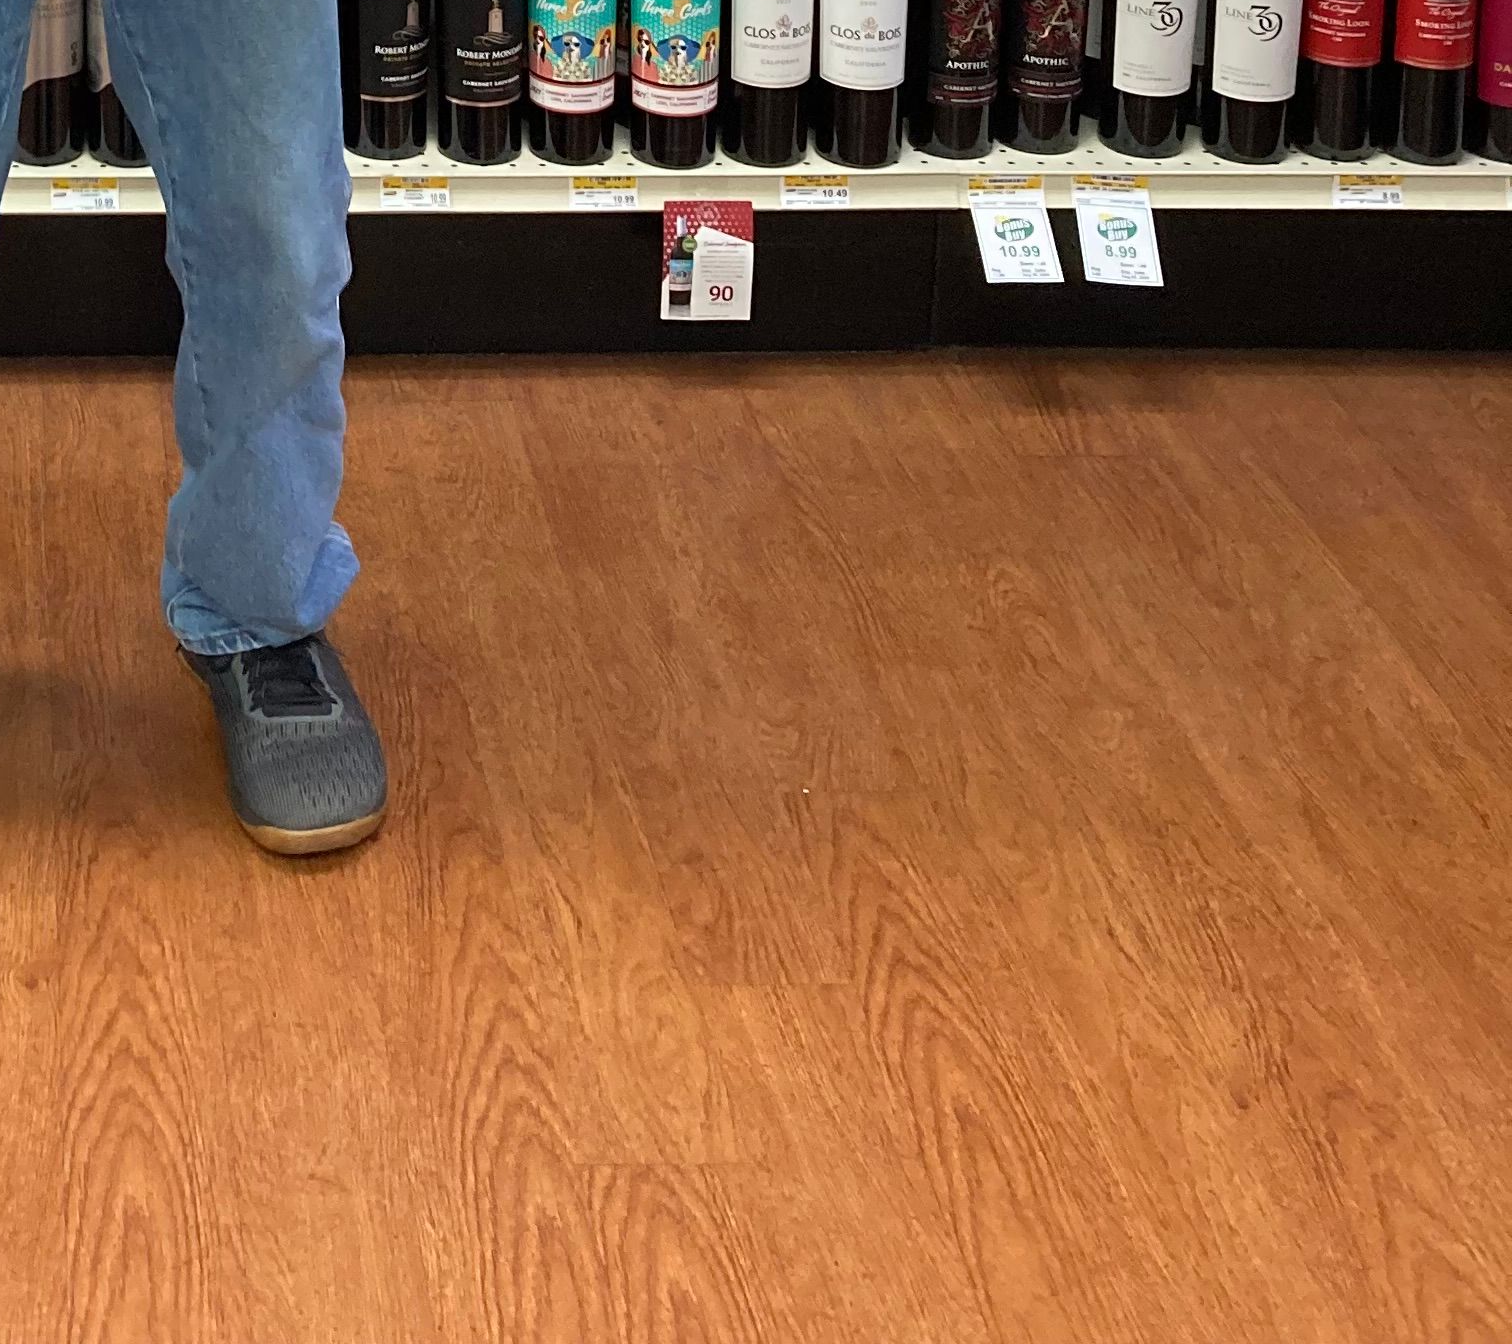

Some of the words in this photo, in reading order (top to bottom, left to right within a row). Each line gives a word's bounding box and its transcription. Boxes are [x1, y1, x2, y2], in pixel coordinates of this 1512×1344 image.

[678, 1, 713, 20] Girls
[1127, 3, 1155, 17] LINE
[1150, 1, 1184, 37] 39
[1225, 6, 1253, 20] LINE
[1248, 4, 1284, 42] 39
[1347, 18, 1371, 28] LOON
[1415, 18, 1455, 29] SMOKING
[744, 26, 776, 39] CLOS
[792, 22, 811, 38] BOIS
[830, 24, 862, 40] CLOS
[878, 27, 902, 41] BOIS
[375, 43, 407, 55] ROBERT
[456, 47, 491, 60] ROBERT
[946, 59, 990, 70] APOTHIC
[1023, 54, 1069, 66] APOTHIC
[943, 82, 976, 91] CABERNET
[1020, 77, 1053, 87] CABERNET
[822, 188, 849, 198] 10.49
[94, 197, 114, 208] 10.99
[613, 195, 635, 204] 10.99
[999, 245, 1041, 258] 10.99
[1105, 245, 1137, 259] 8.99
[709, 284, 734, 302] 90
